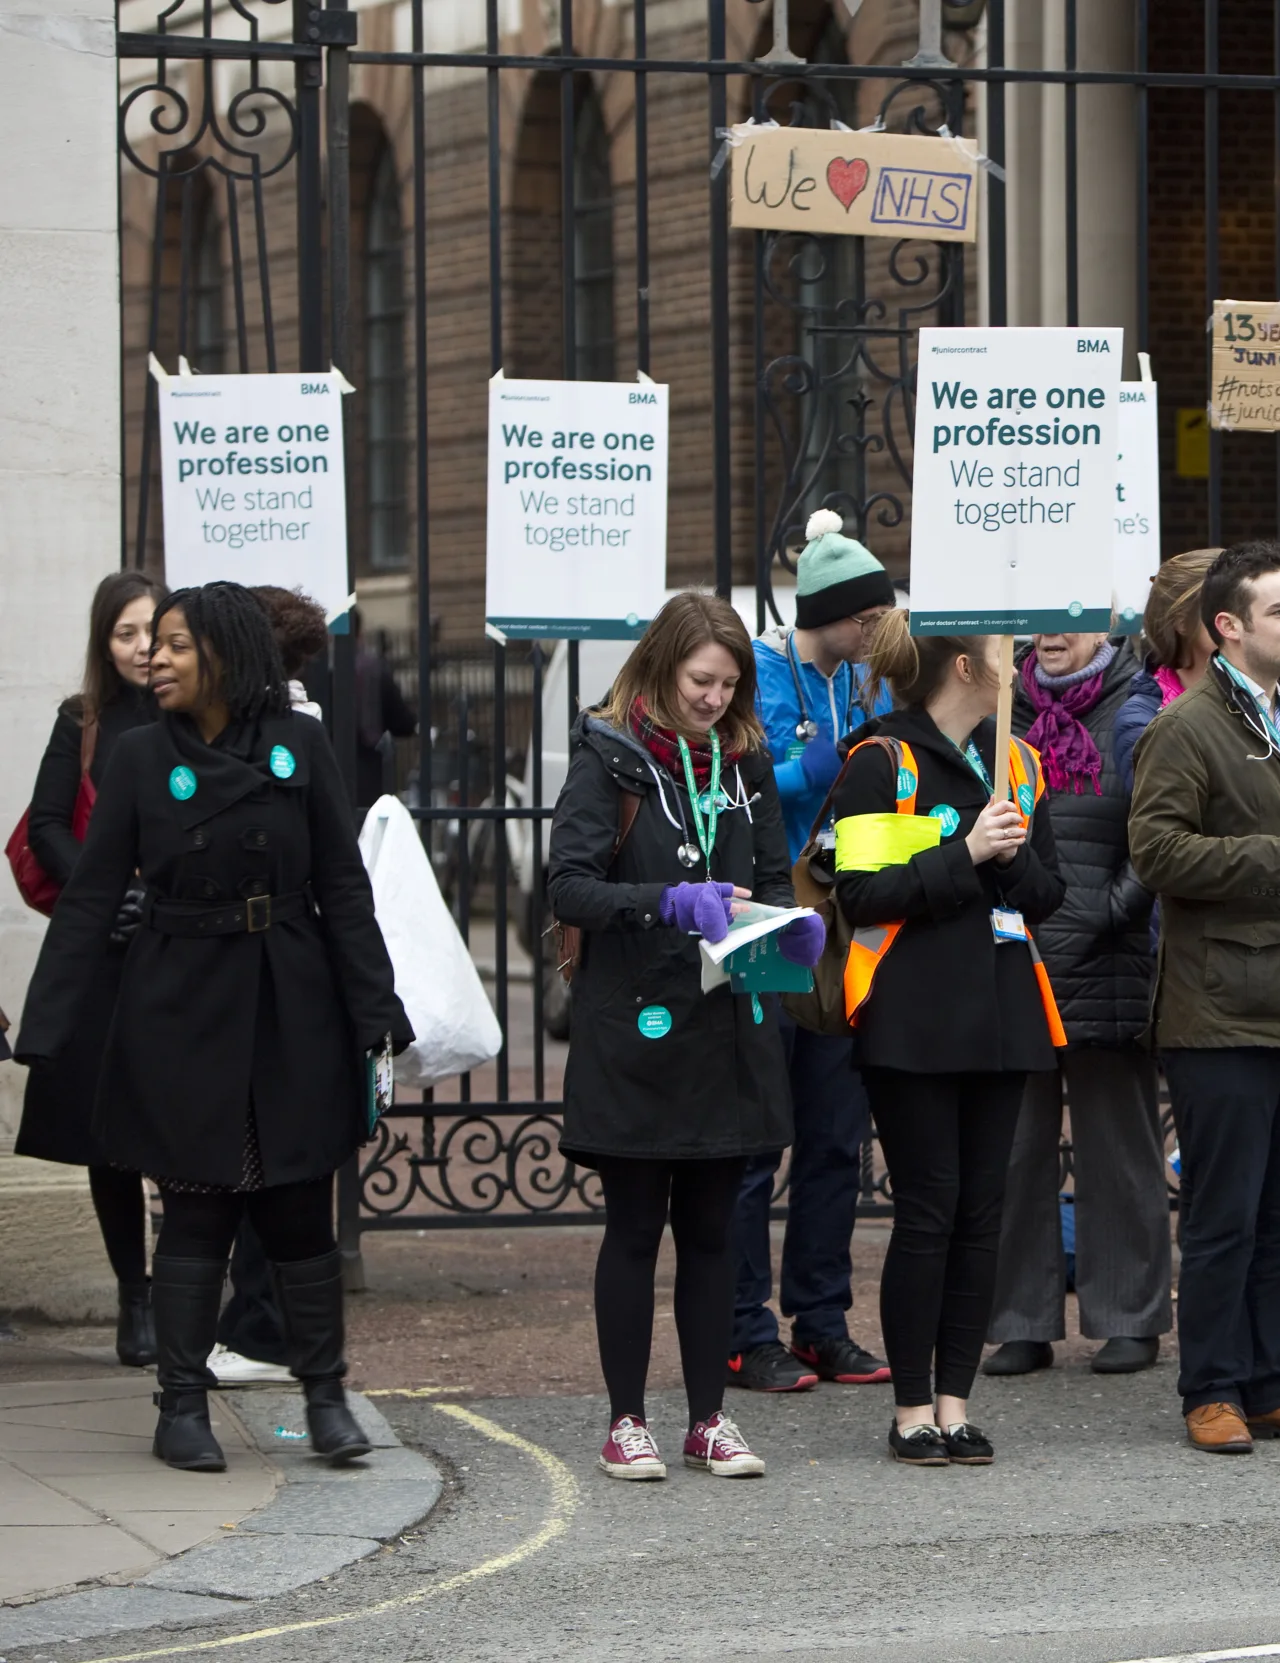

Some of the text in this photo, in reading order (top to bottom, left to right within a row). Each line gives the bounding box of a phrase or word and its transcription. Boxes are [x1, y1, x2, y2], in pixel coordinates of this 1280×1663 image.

[744, 145, 963, 224] We NHS
[1223, 311, 1256, 342] 13
[931, 339, 1111, 355] #juniorcontract BMA
[300, 383, 330, 395] BMA
[628, 392, 657, 404] BMA
[931, 382, 1106, 409] We are one
[1119, 391, 1147, 403] BMA
[173, 421, 330, 445] We are one
[501, 424, 655, 451] We are one
[933, 416, 1101, 453] profession
[178, 450, 328, 482] profession
[504, 455, 652, 484] profession
[950, 458, 1080, 488] We stand
[195, 485, 313, 512] We stand
[520, 490, 635, 517] We stand
[954, 495, 1076, 532] together
[201, 516, 311, 549] together
[524, 522, 631, 552] together
